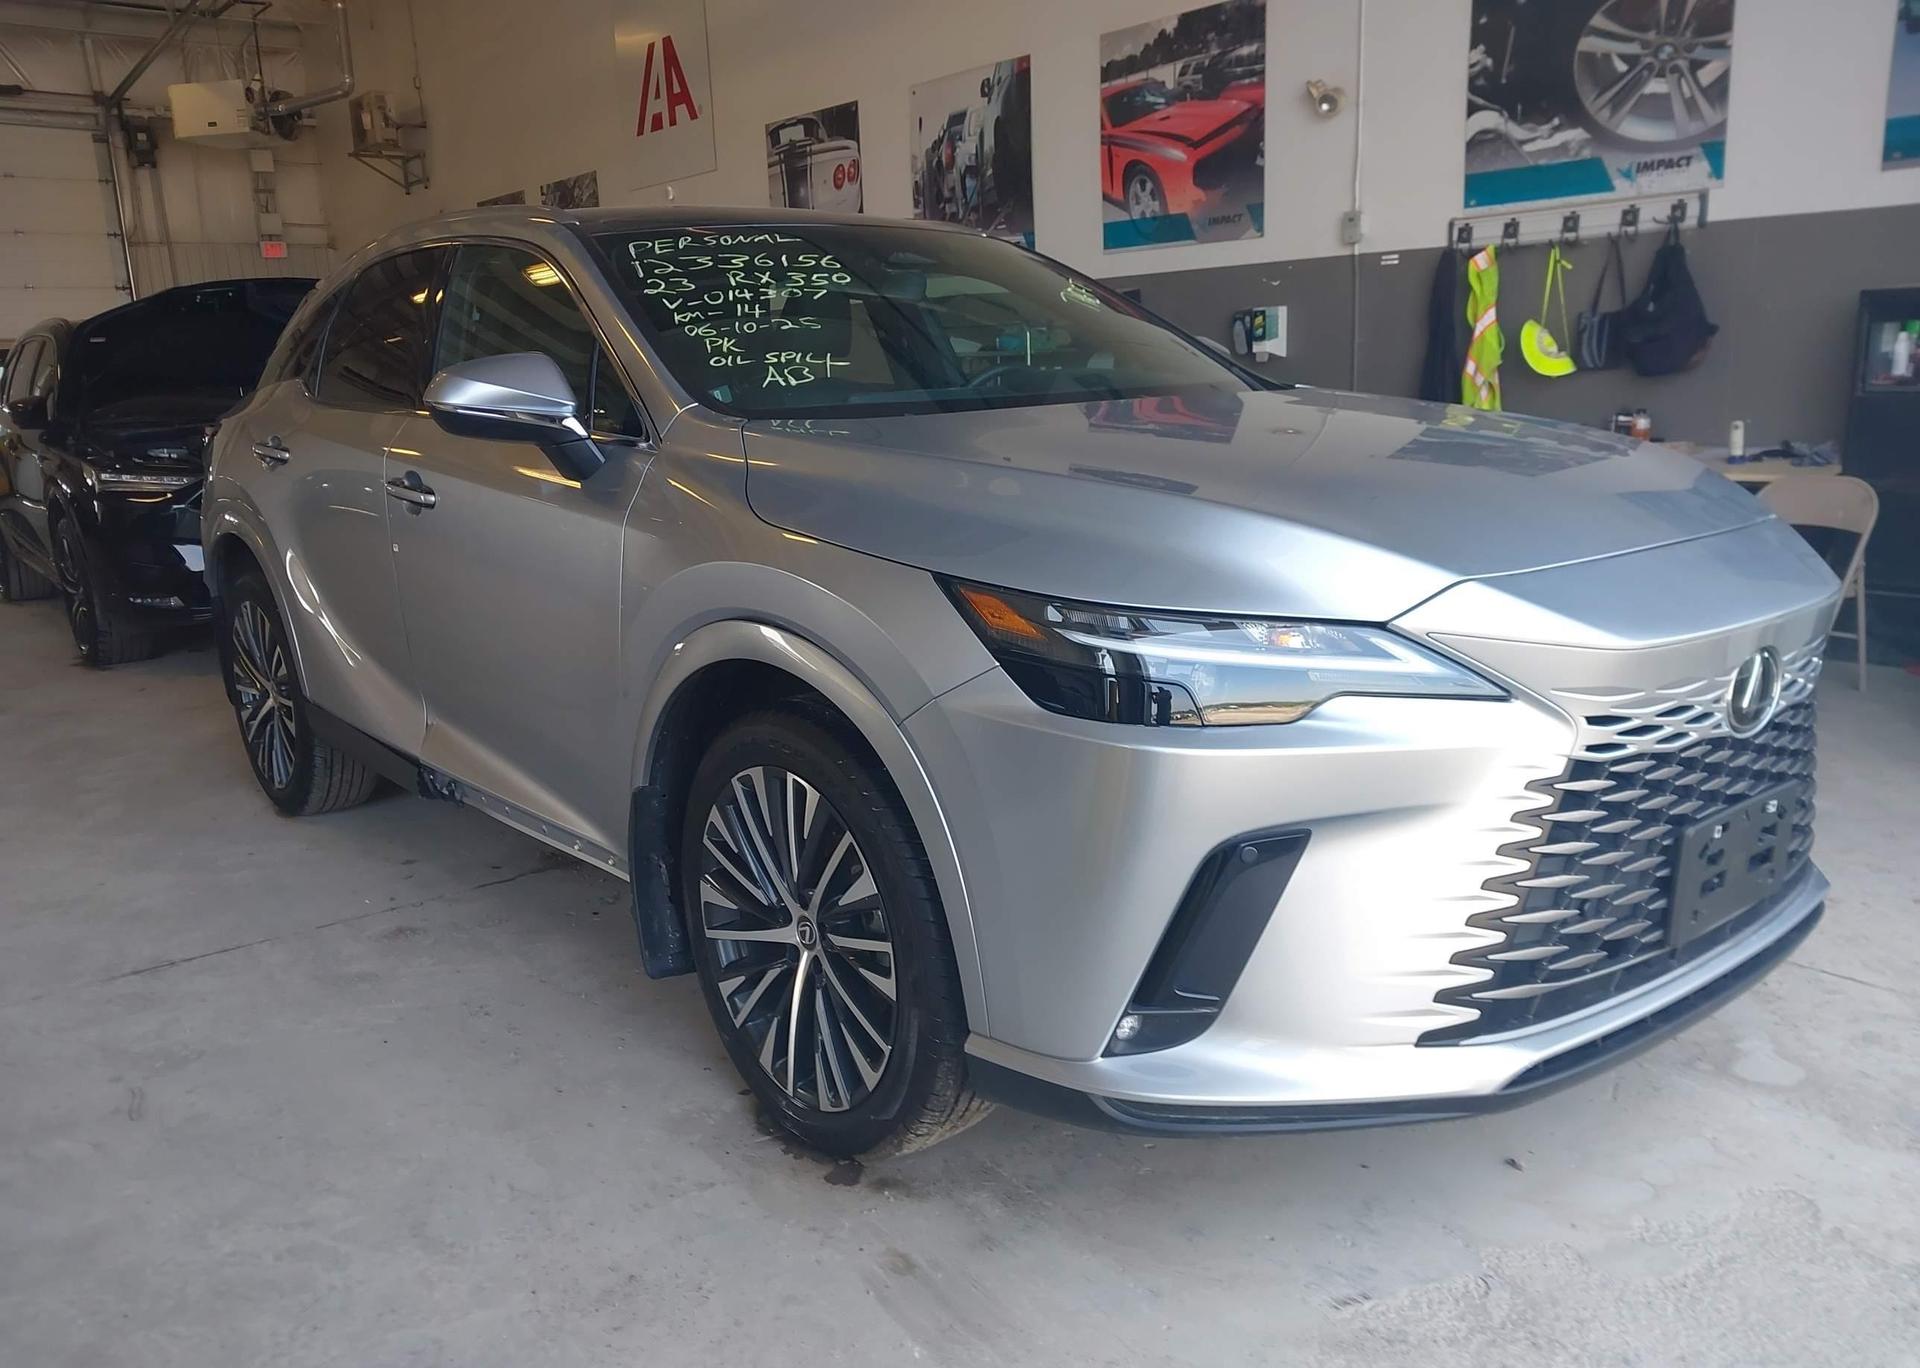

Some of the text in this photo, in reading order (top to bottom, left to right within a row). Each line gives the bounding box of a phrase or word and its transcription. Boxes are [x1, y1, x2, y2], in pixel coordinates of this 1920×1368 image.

[1636, 155, 1694, 174] IMPACT
[1207, 213, 1244, 226] IMPACT
[628, 233, 801, 259] PERSONAL
[631, 252, 842, 278] 12336156
[643, 270, 851, 295] 23 RX 350
[735, 303, 767, 319] 14
[684, 316, 822, 337] 06-10-25
[703, 336, 746, 354] PK
[709, 355, 756, 367] OIL
